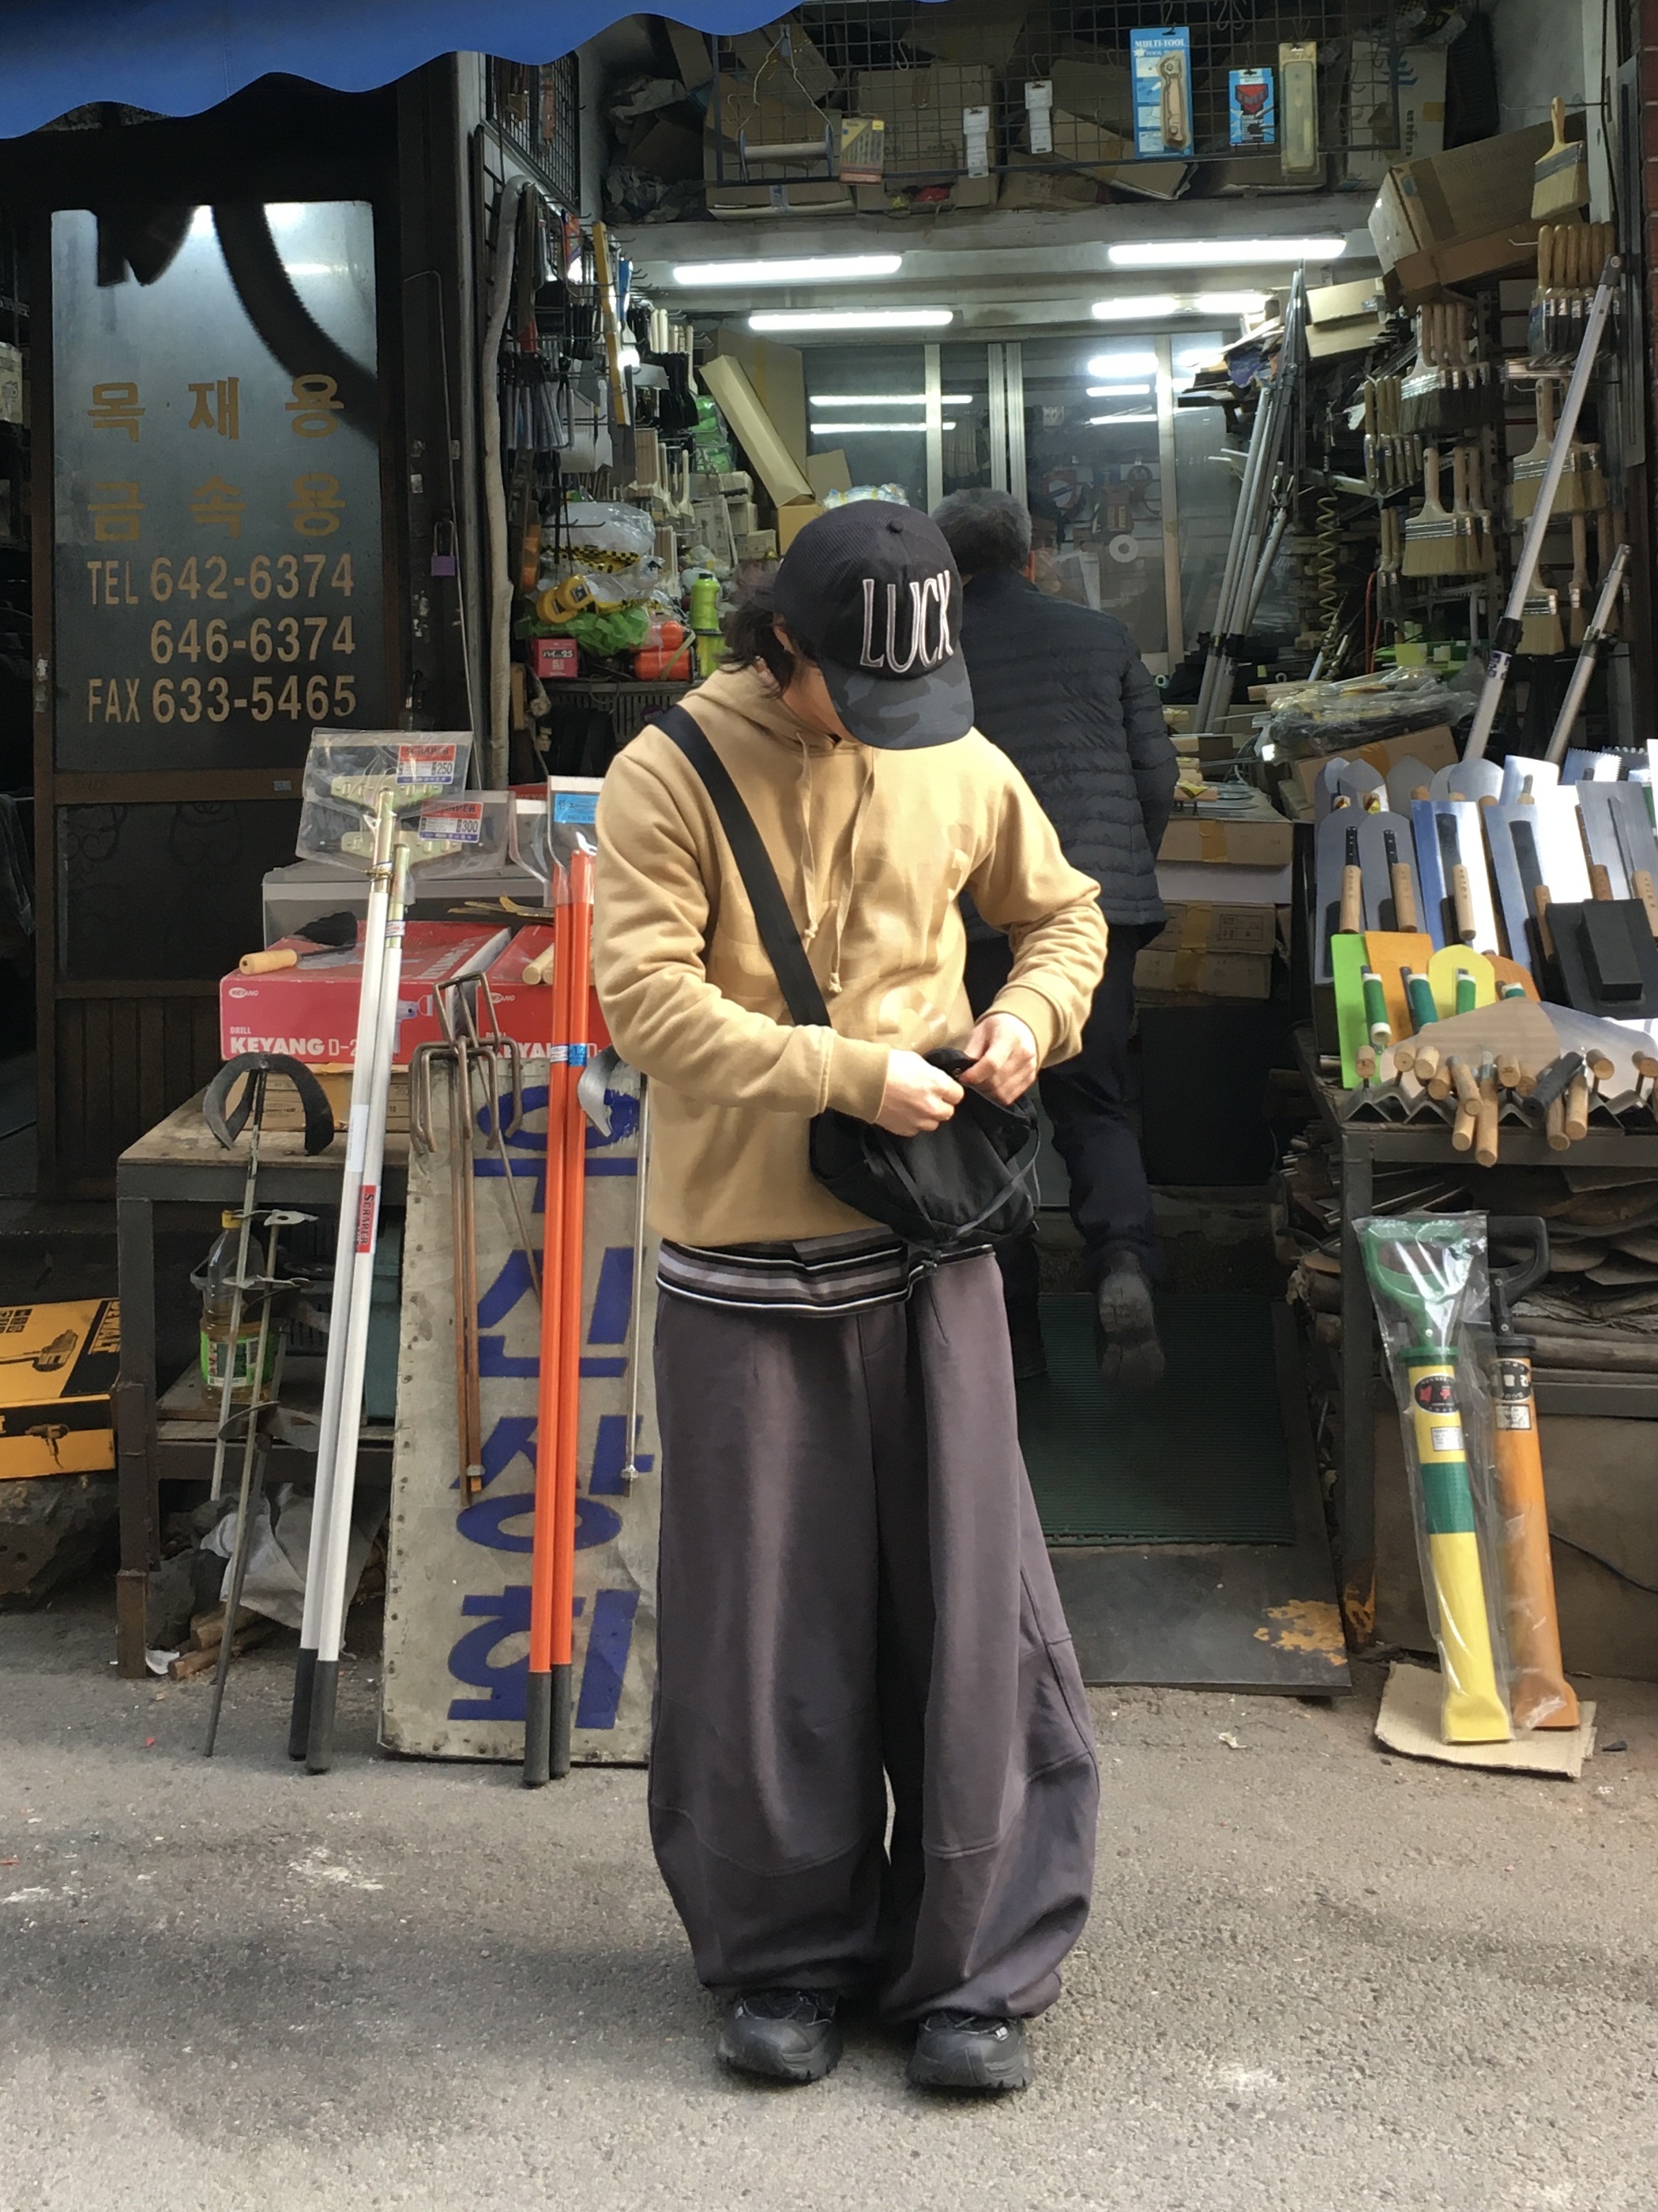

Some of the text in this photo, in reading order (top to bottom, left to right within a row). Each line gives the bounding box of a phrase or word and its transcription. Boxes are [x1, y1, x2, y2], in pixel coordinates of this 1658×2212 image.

[1134, 39, 1185, 47] MULTI-TOOL
[87, 373, 345, 442] 목재용
[87, 472, 346, 542] 금속용
[87, 553, 355, 605] TEL 642-6374
[150, 615, 356, 664] 646-6374
[859, 570, 954, 674] LUCK
[88, 675, 357, 724] FAX 633-5465
[436, 762, 453, 775] 250
[461, 820, 479, 833] 300
[230, 1026, 252, 1035] DRILL
[230, 1036, 325, 1055] KEYANG
[359, 1193, 375, 1245] SCRAPER
